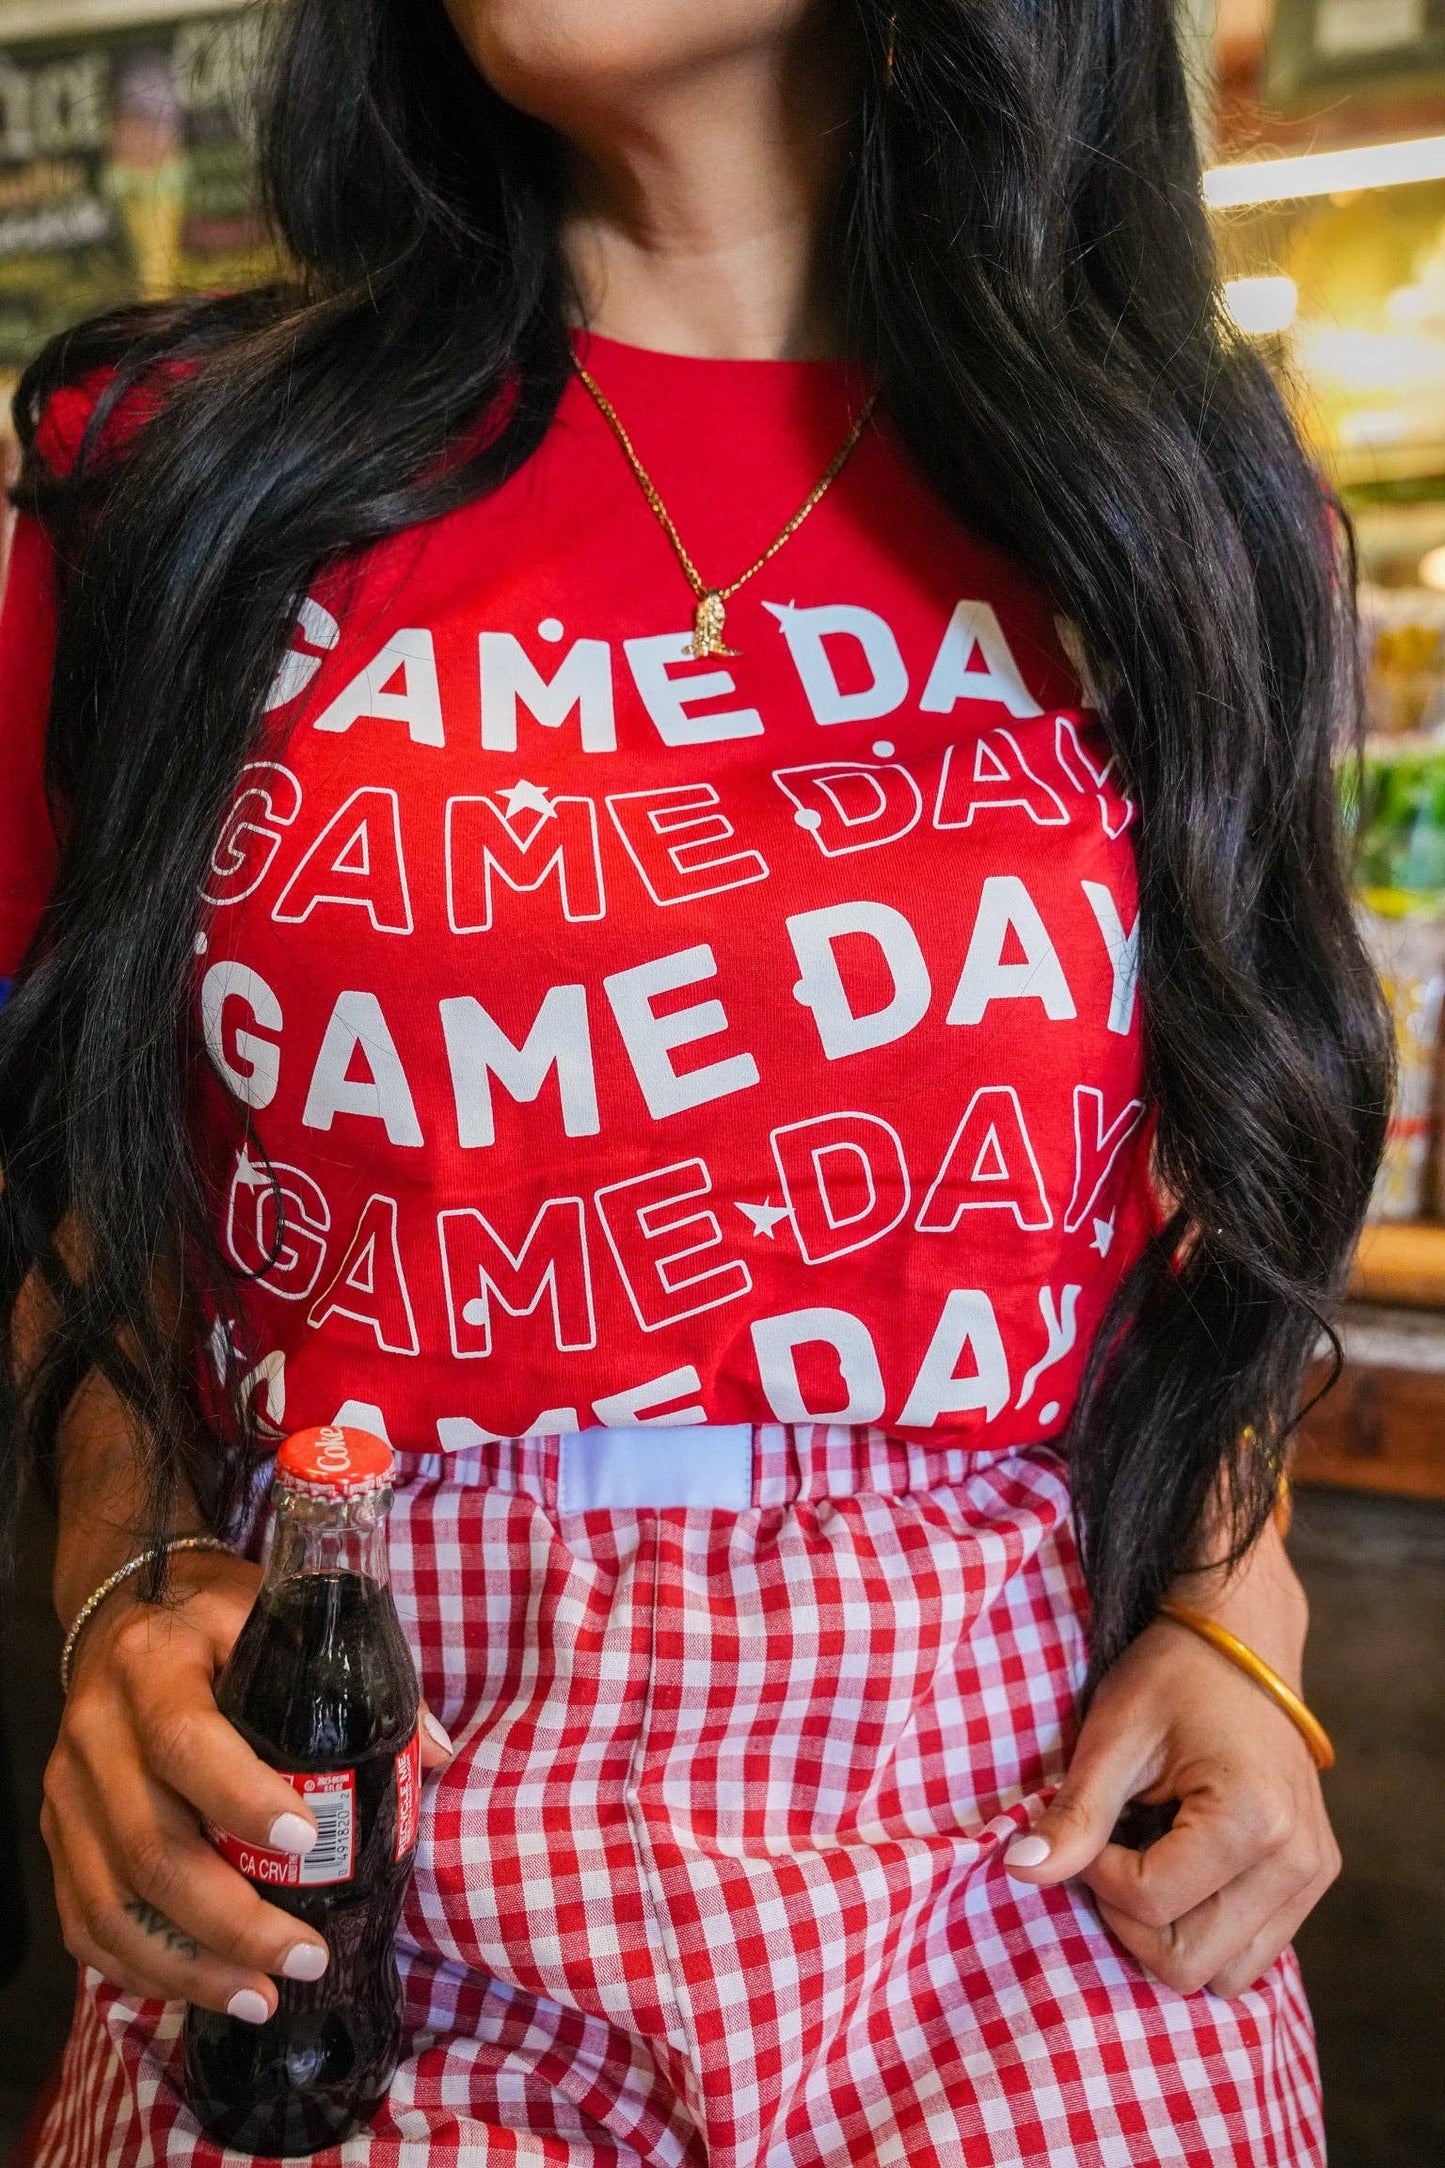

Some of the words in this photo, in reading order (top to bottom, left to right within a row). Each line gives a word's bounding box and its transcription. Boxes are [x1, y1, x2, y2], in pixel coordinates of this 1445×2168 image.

[199, 761, 770, 935] GAME
[201, 944, 760, 1148] GAME
[226, 1157, 753, 1359] GAME
[769, 1084, 1146, 1266] DAY
[314, 1426, 351, 1472] Coke
[239, 1852, 256, 1876] CA
[258, 1859, 289, 1883] CRV
